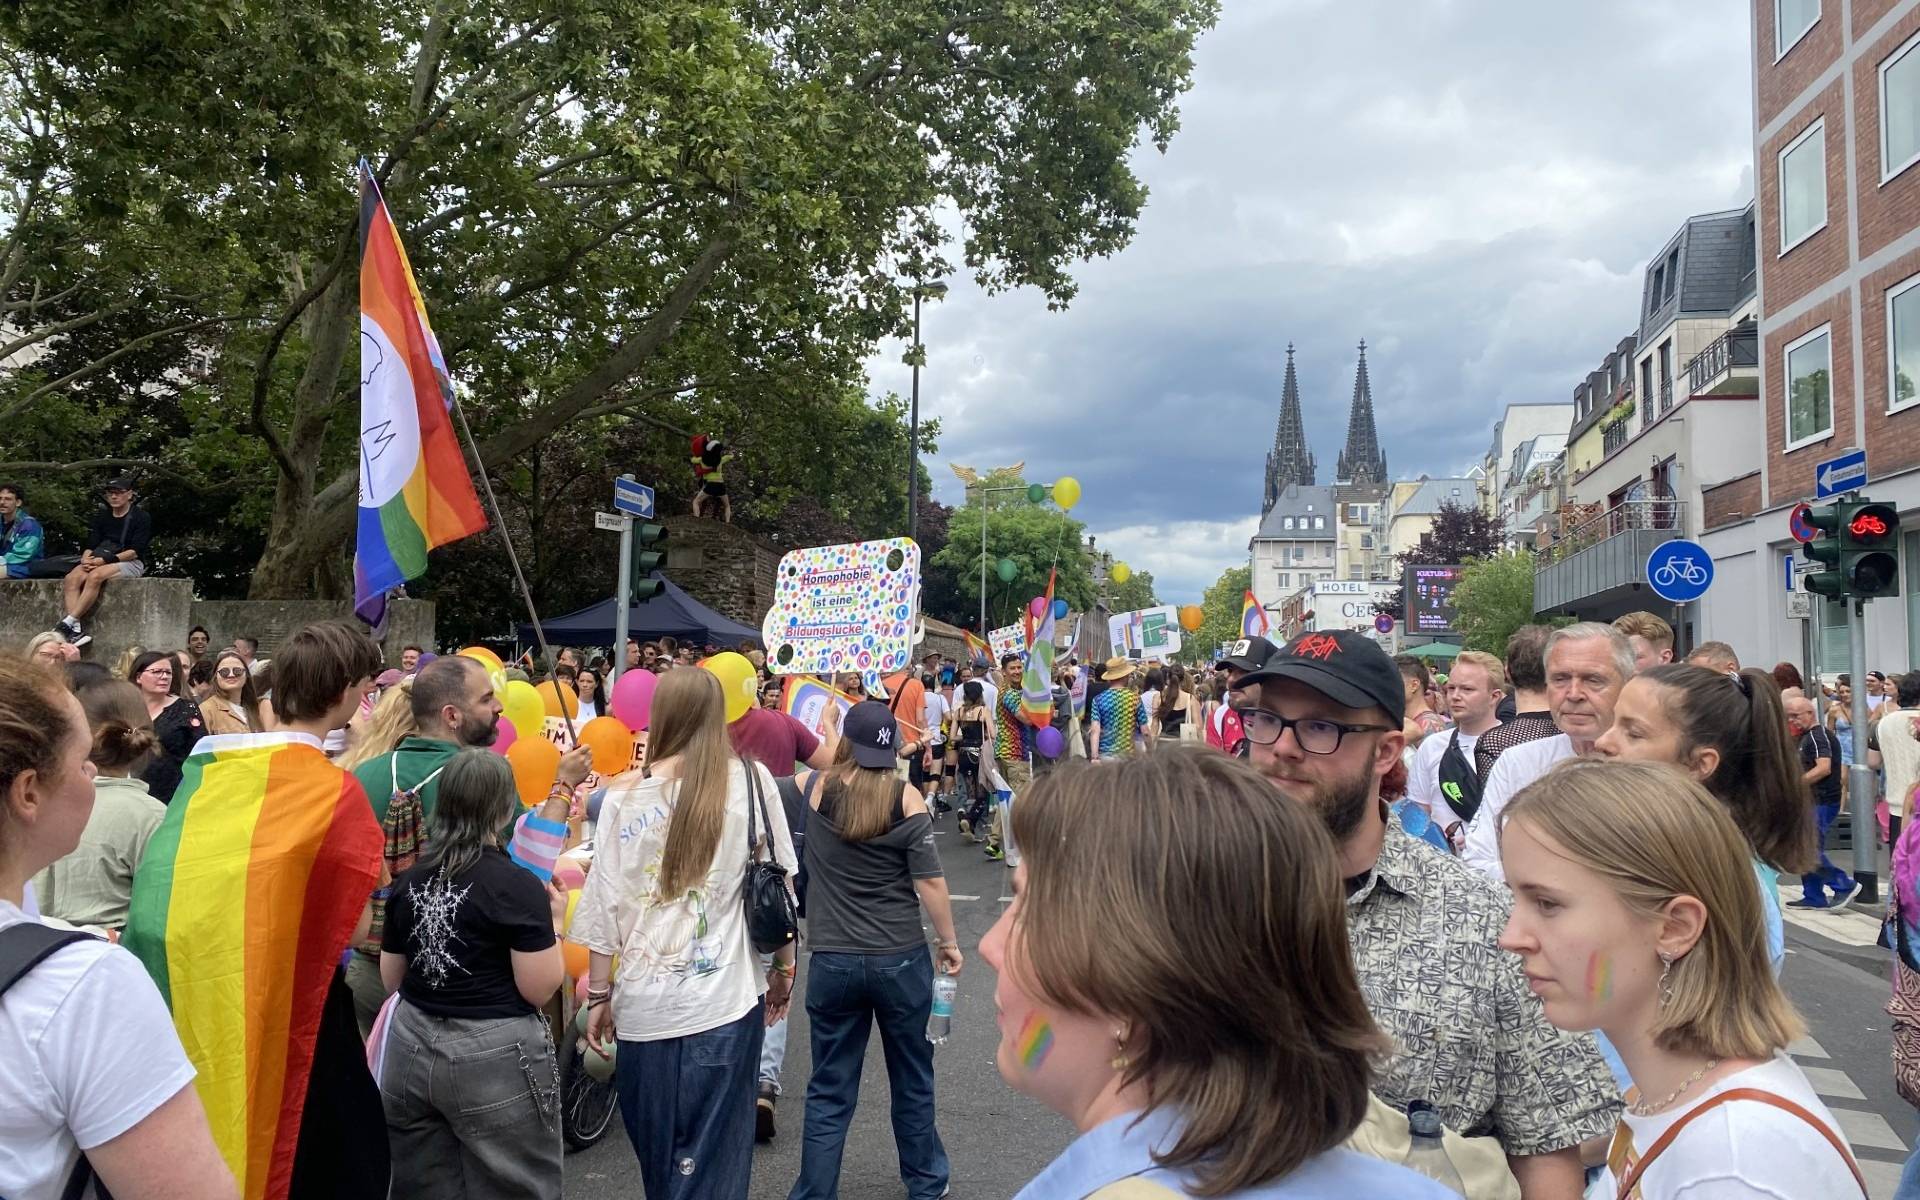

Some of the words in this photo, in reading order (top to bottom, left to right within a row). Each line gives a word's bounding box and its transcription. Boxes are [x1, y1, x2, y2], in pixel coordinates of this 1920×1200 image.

[802, 569, 869, 584] Homophobie
[1322, 583, 1364, 592] HOTEL
[812, 598, 826, 607] ist
[829, 596, 853, 606] eine
